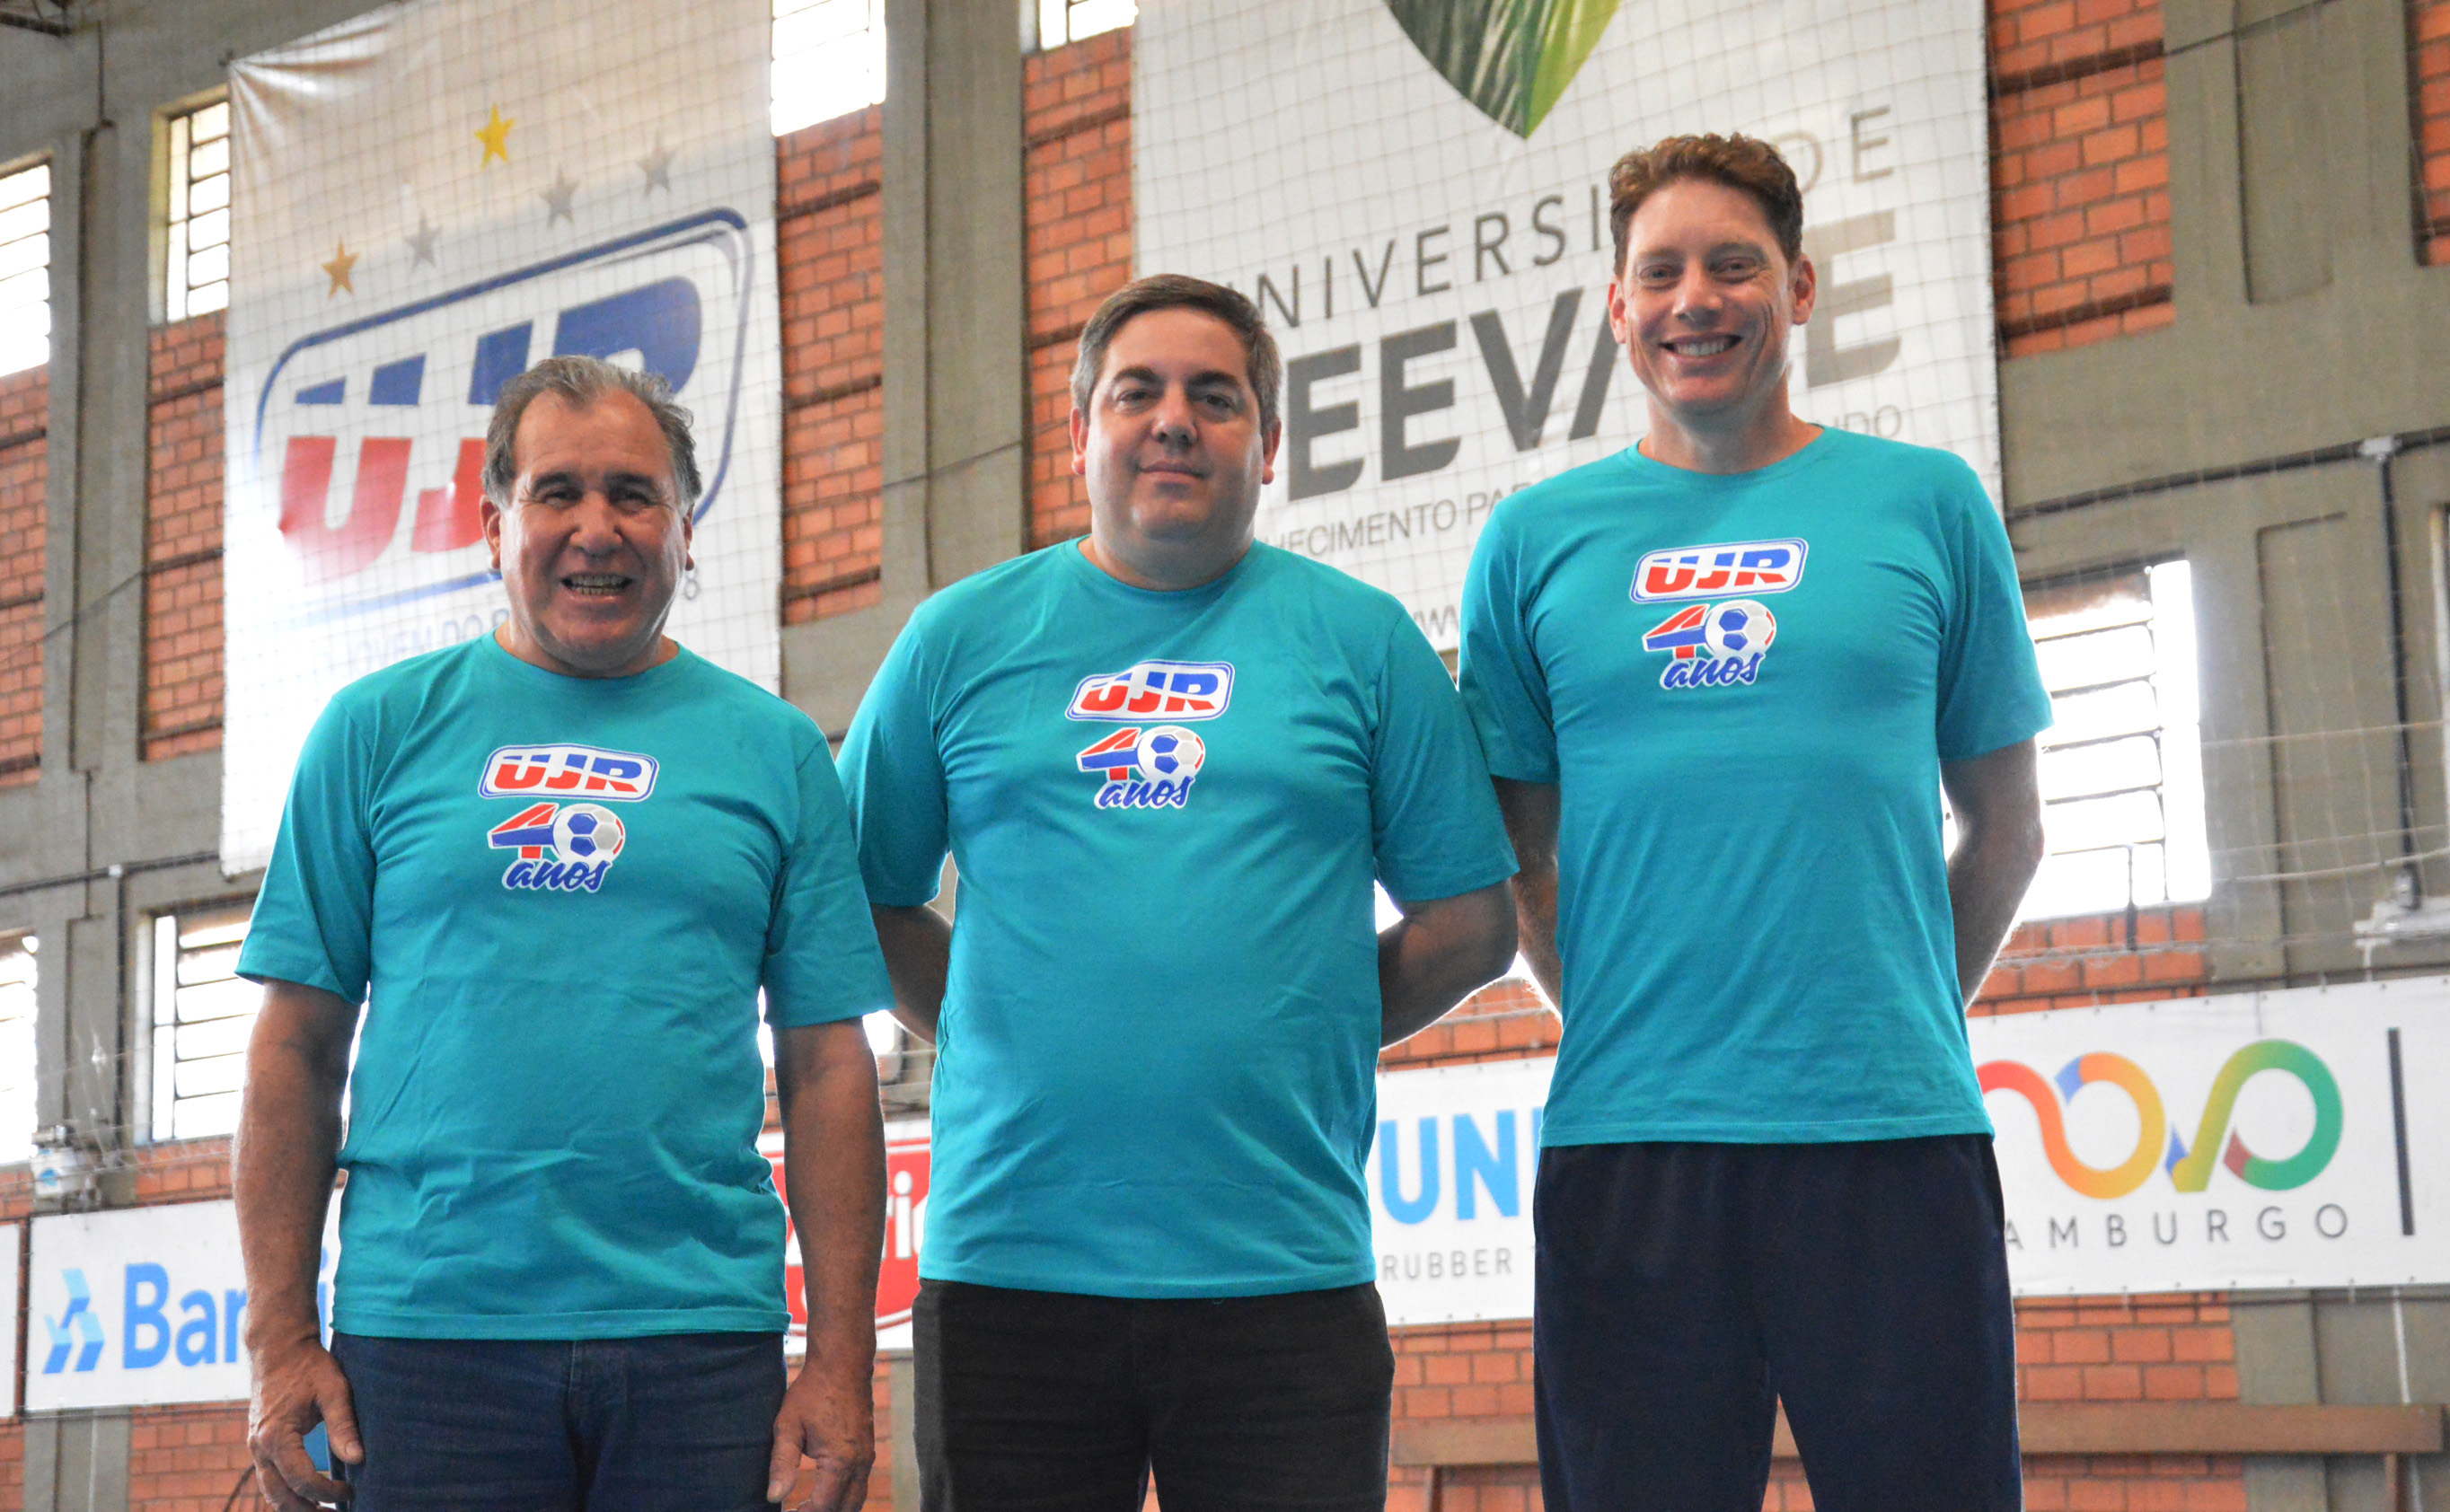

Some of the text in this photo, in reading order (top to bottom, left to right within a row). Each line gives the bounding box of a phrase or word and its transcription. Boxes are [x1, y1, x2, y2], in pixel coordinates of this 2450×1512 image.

[1644, 549, 1791, 594] UJR
[1661, 652, 1766, 690] anos
[1080, 671, 1219, 713] UJR
[494, 752, 642, 793] UJR
[1095, 775, 1195, 809] anos
[502, 859, 612, 893] anos
[2004, 1203, 2349, 1251] AMBURGO
[1381, 1247, 1512, 1281] RUBBER
